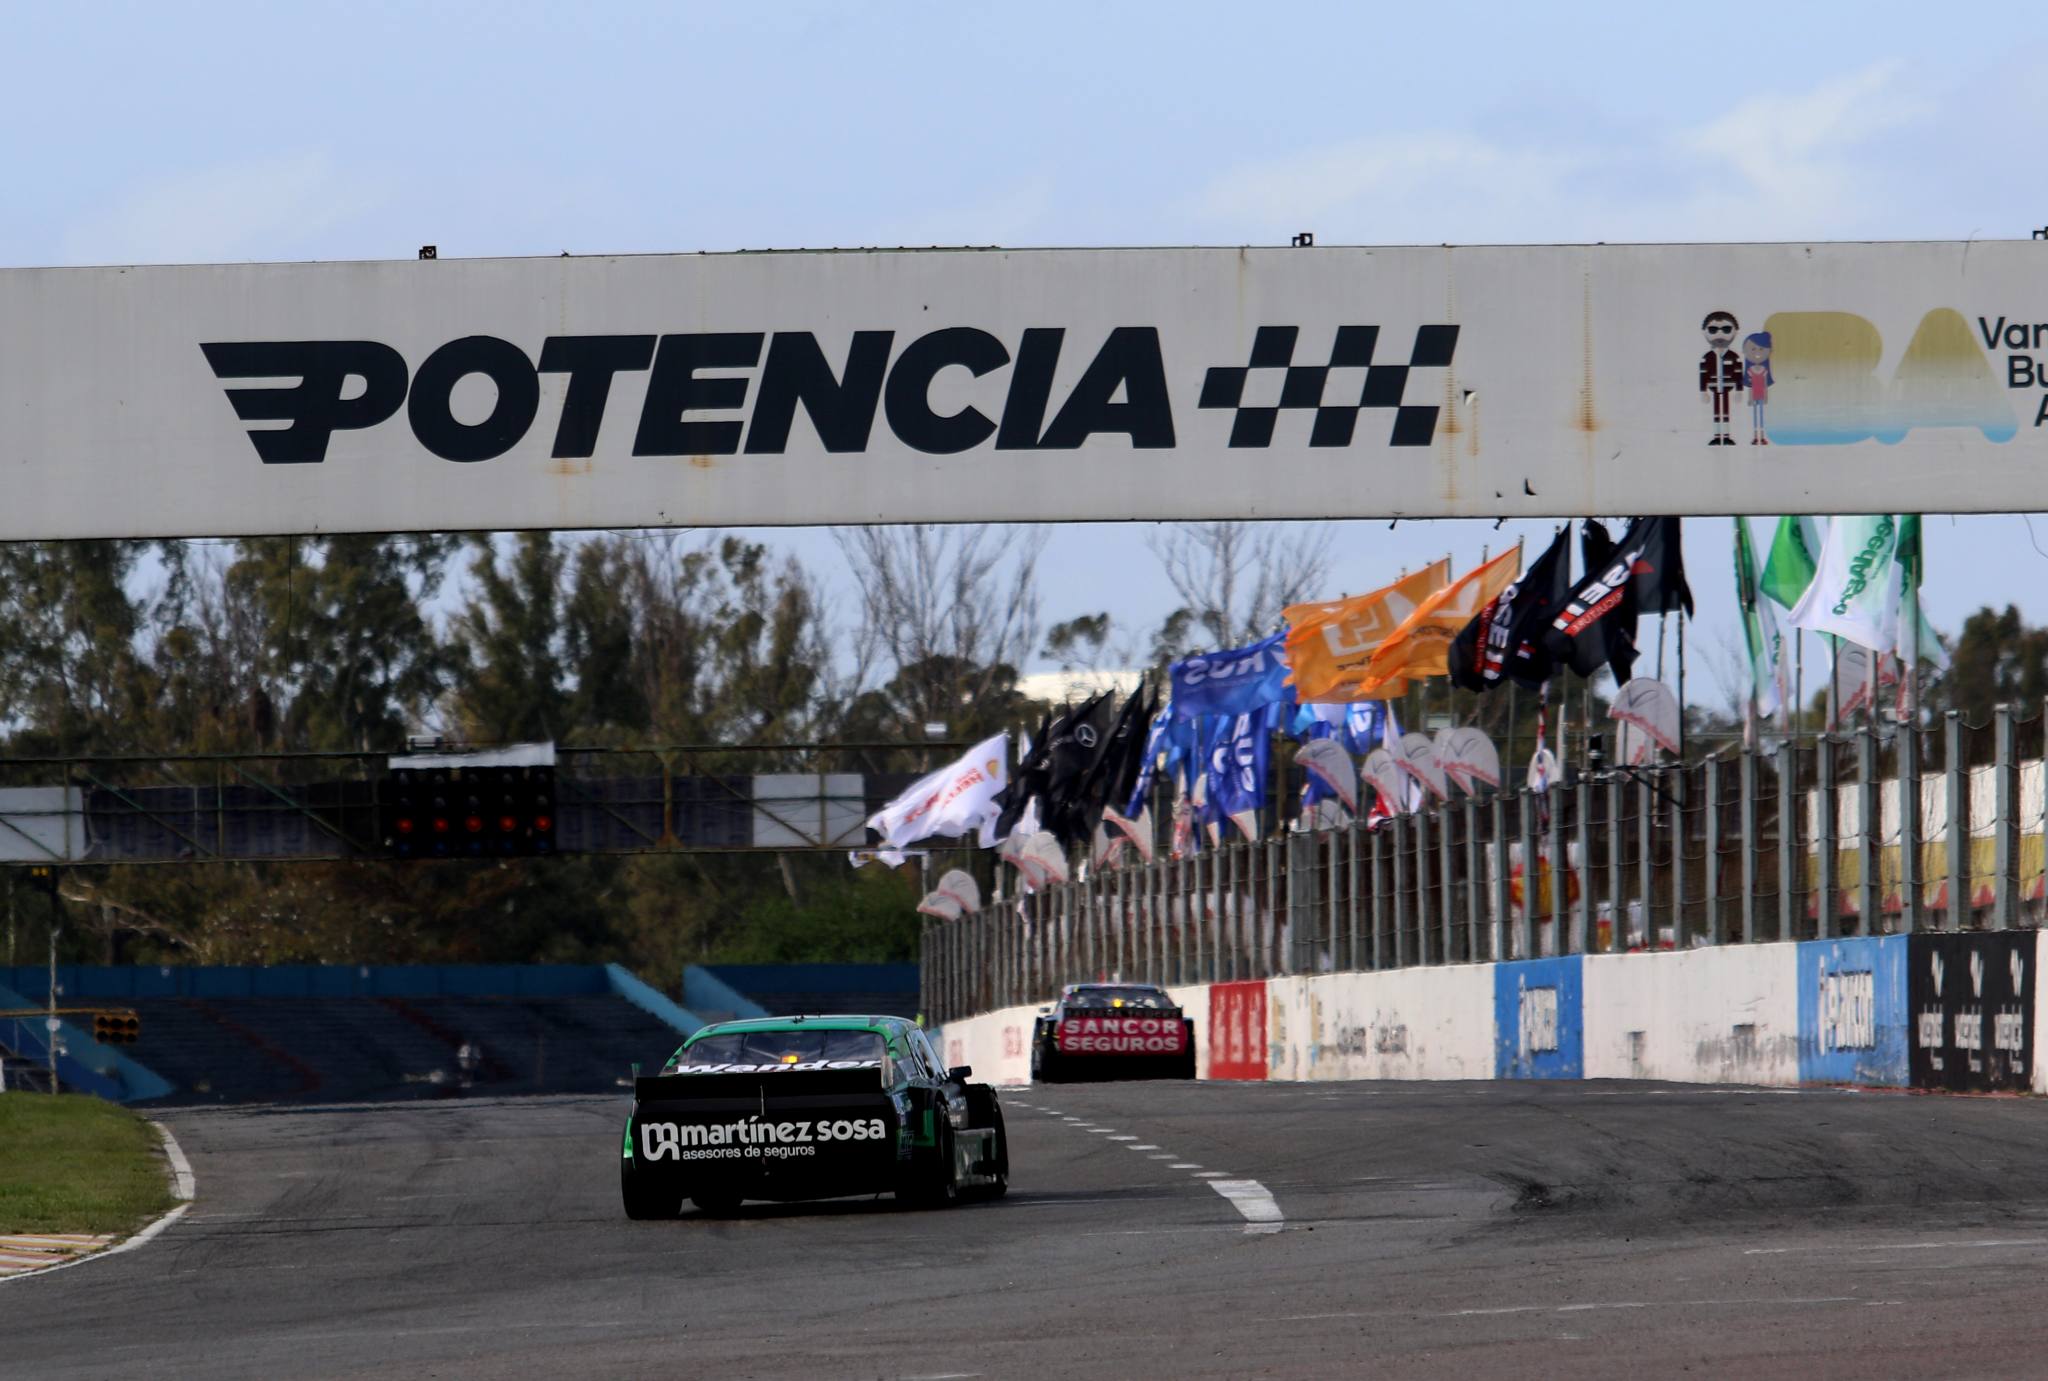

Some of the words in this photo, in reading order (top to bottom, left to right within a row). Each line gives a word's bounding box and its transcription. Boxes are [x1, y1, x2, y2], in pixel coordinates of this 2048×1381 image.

[199, 326, 1175, 464] POTENCIA
[1064, 1019, 1179, 1035] SANCOR
[1064, 1036, 1180, 1052] SEGUROS
[681, 1115, 813, 1146] martínez
[816, 1119, 886, 1142] sosa
[682, 1146, 742, 1160] asesores
[744, 1146, 761, 1158] de
[764, 1145, 815, 1159] seguros
